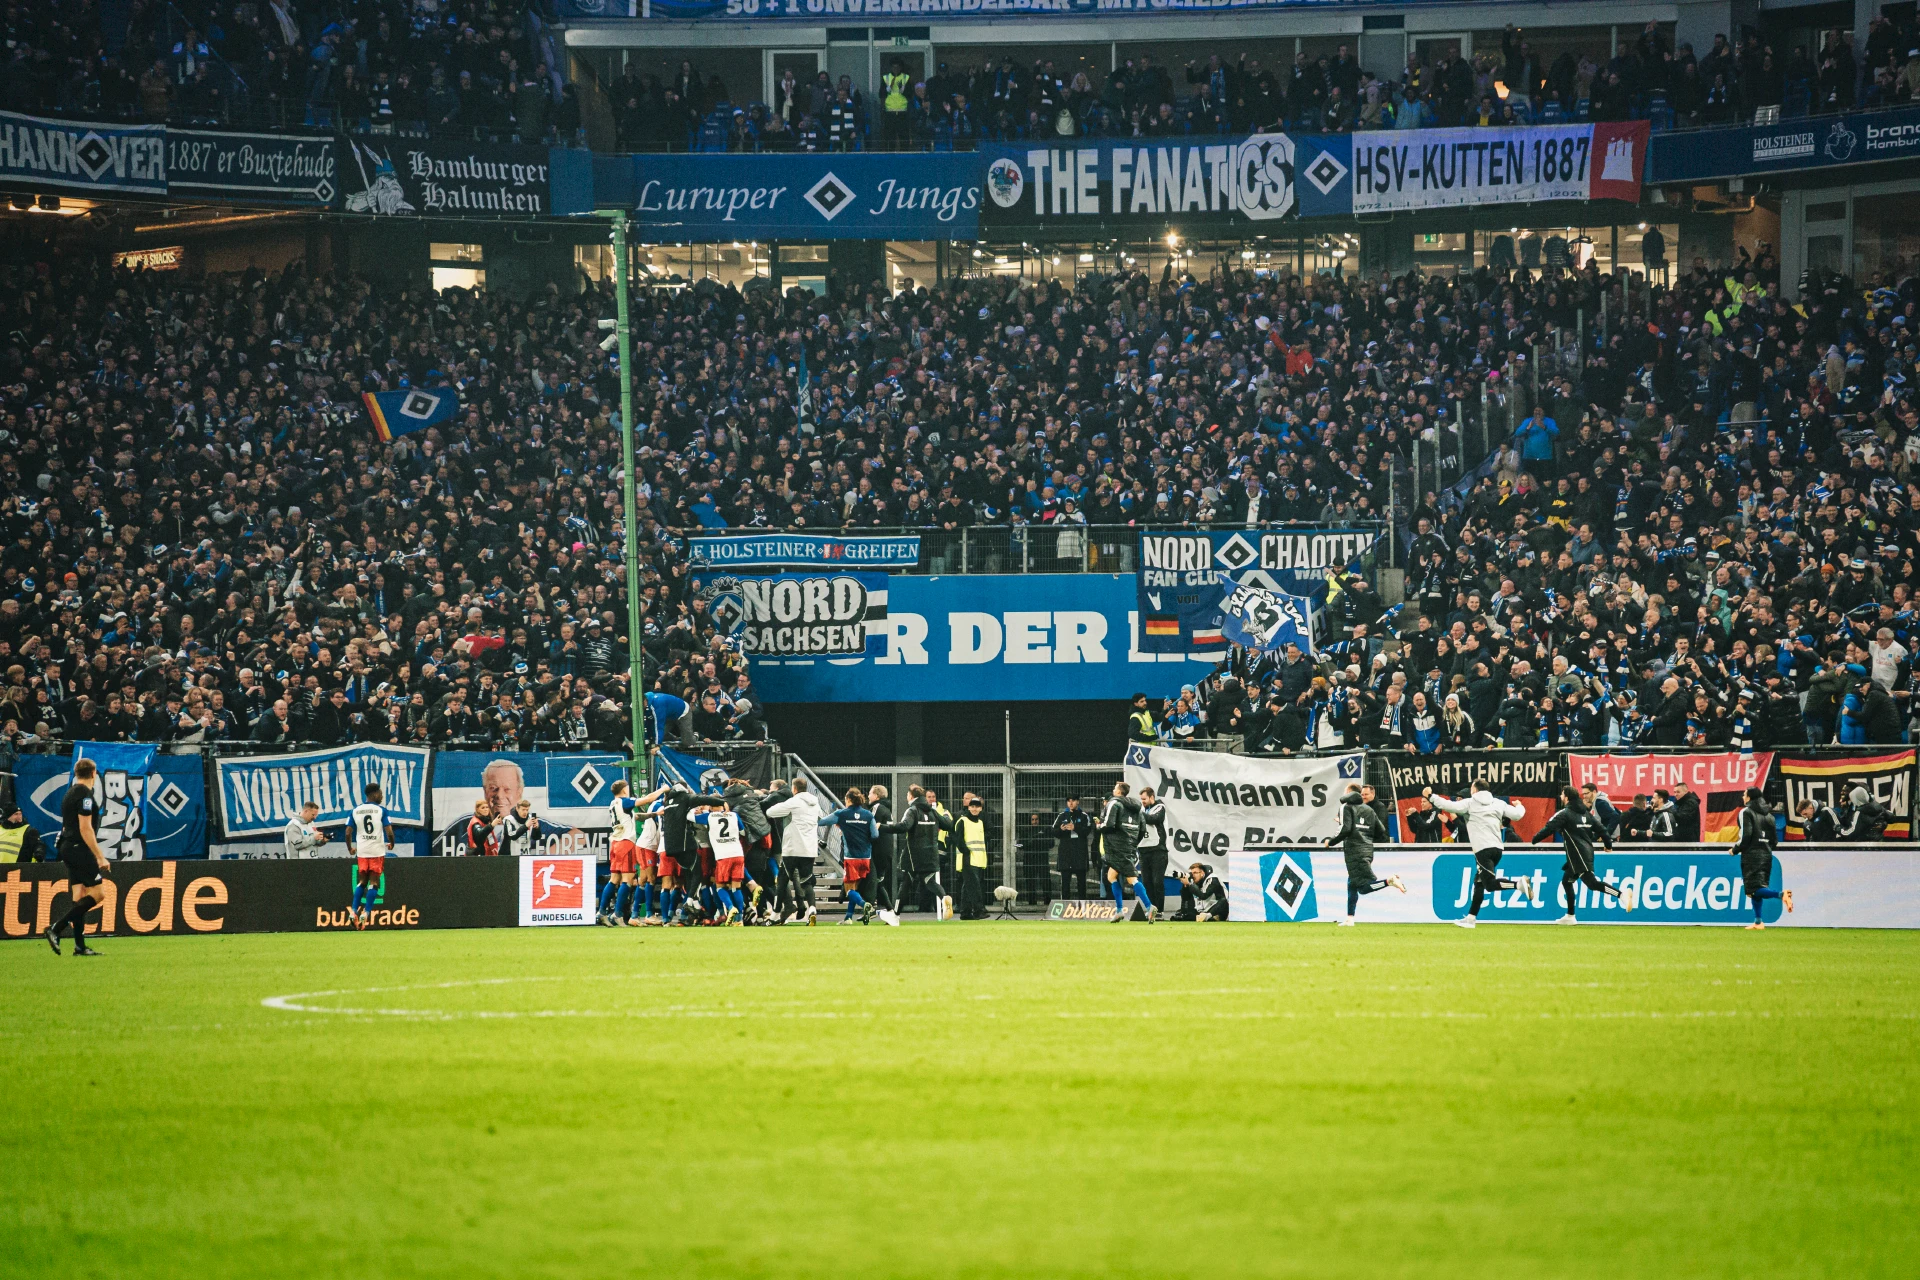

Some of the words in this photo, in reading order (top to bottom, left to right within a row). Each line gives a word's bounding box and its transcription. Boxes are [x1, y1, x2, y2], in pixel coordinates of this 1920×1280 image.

[1754, 133, 1814, 149] HOLSTEINER
[1867, 138, 1920, 150] Hambur
[238, 143, 334, 183] Buxtehude
[407, 151, 548, 186] Hamburger
[1028, 149, 1100, 215] THE
[1112, 139, 1290, 214] FANATICS
[1356, 139, 1527, 194] HSV-KUTTEN
[1534, 136, 1590, 189] 1887
[421, 182, 542, 212] Halunken
[635, 180, 787, 221] Luruper
[869, 179, 980, 221] Jungs
[710, 542, 816, 559] HOLSTEINER
[844, 543, 919, 559] GREIFEN
[1143, 537, 1211, 570] NORD
[1261, 534, 1374, 569] CHAOTEN
[741, 578, 862, 622] NORD
[1177, 595, 1199, 604] von
[744, 624, 861, 651] SACHSEN
[949, 611, 1108, 664] DER
[1392, 761, 1558, 787] KRAWATTENFRONT
[1581, 764, 1626, 786] HSV
[1636, 763, 1683, 786] FAN
[1692, 760, 1759, 784] CLUB
[230, 755, 416, 824] NORDHAUSEN
[364, 815, 374, 834] 6
[718, 818, 730, 837] 2
[1454, 865, 1547, 909] Jtzt
[532, 914, 583, 922] BUNDESLIGA
